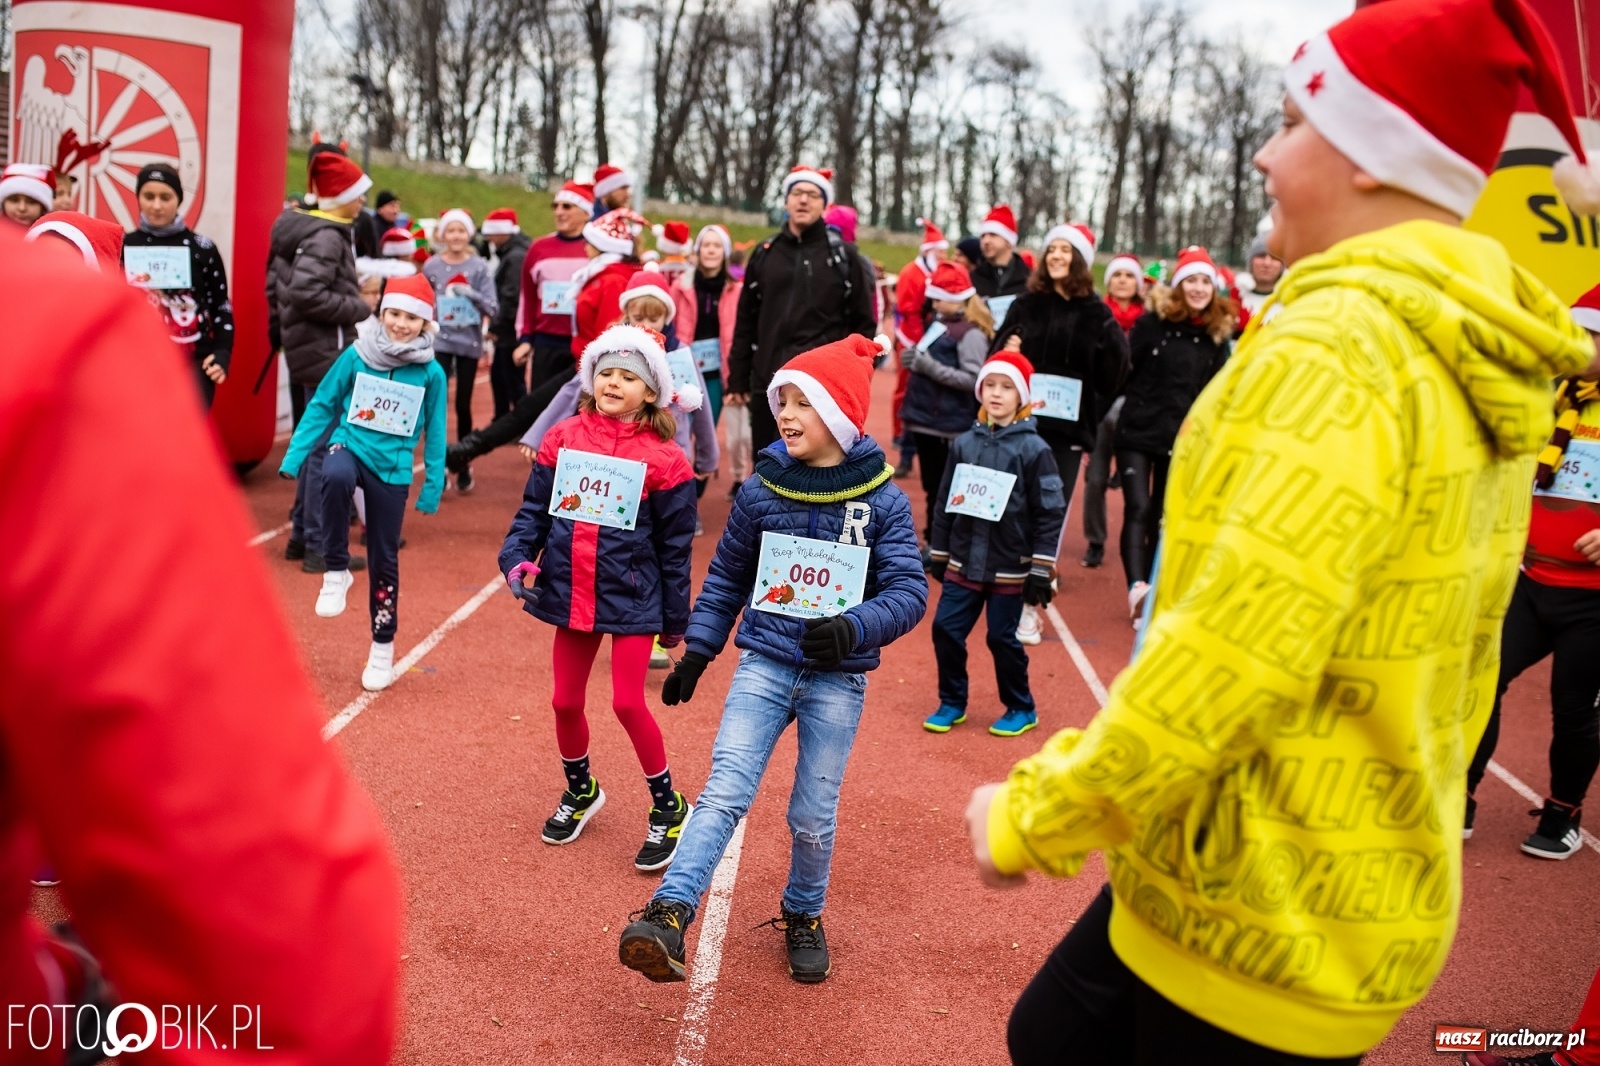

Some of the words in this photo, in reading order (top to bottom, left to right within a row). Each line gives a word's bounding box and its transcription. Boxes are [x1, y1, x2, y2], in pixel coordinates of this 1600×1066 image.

[374, 396, 400, 413] 207
[579, 476, 611, 498] 041
[966, 483, 987, 497] 100
[770, 547, 794, 559] Bieg
[789, 563, 831, 588] 060
